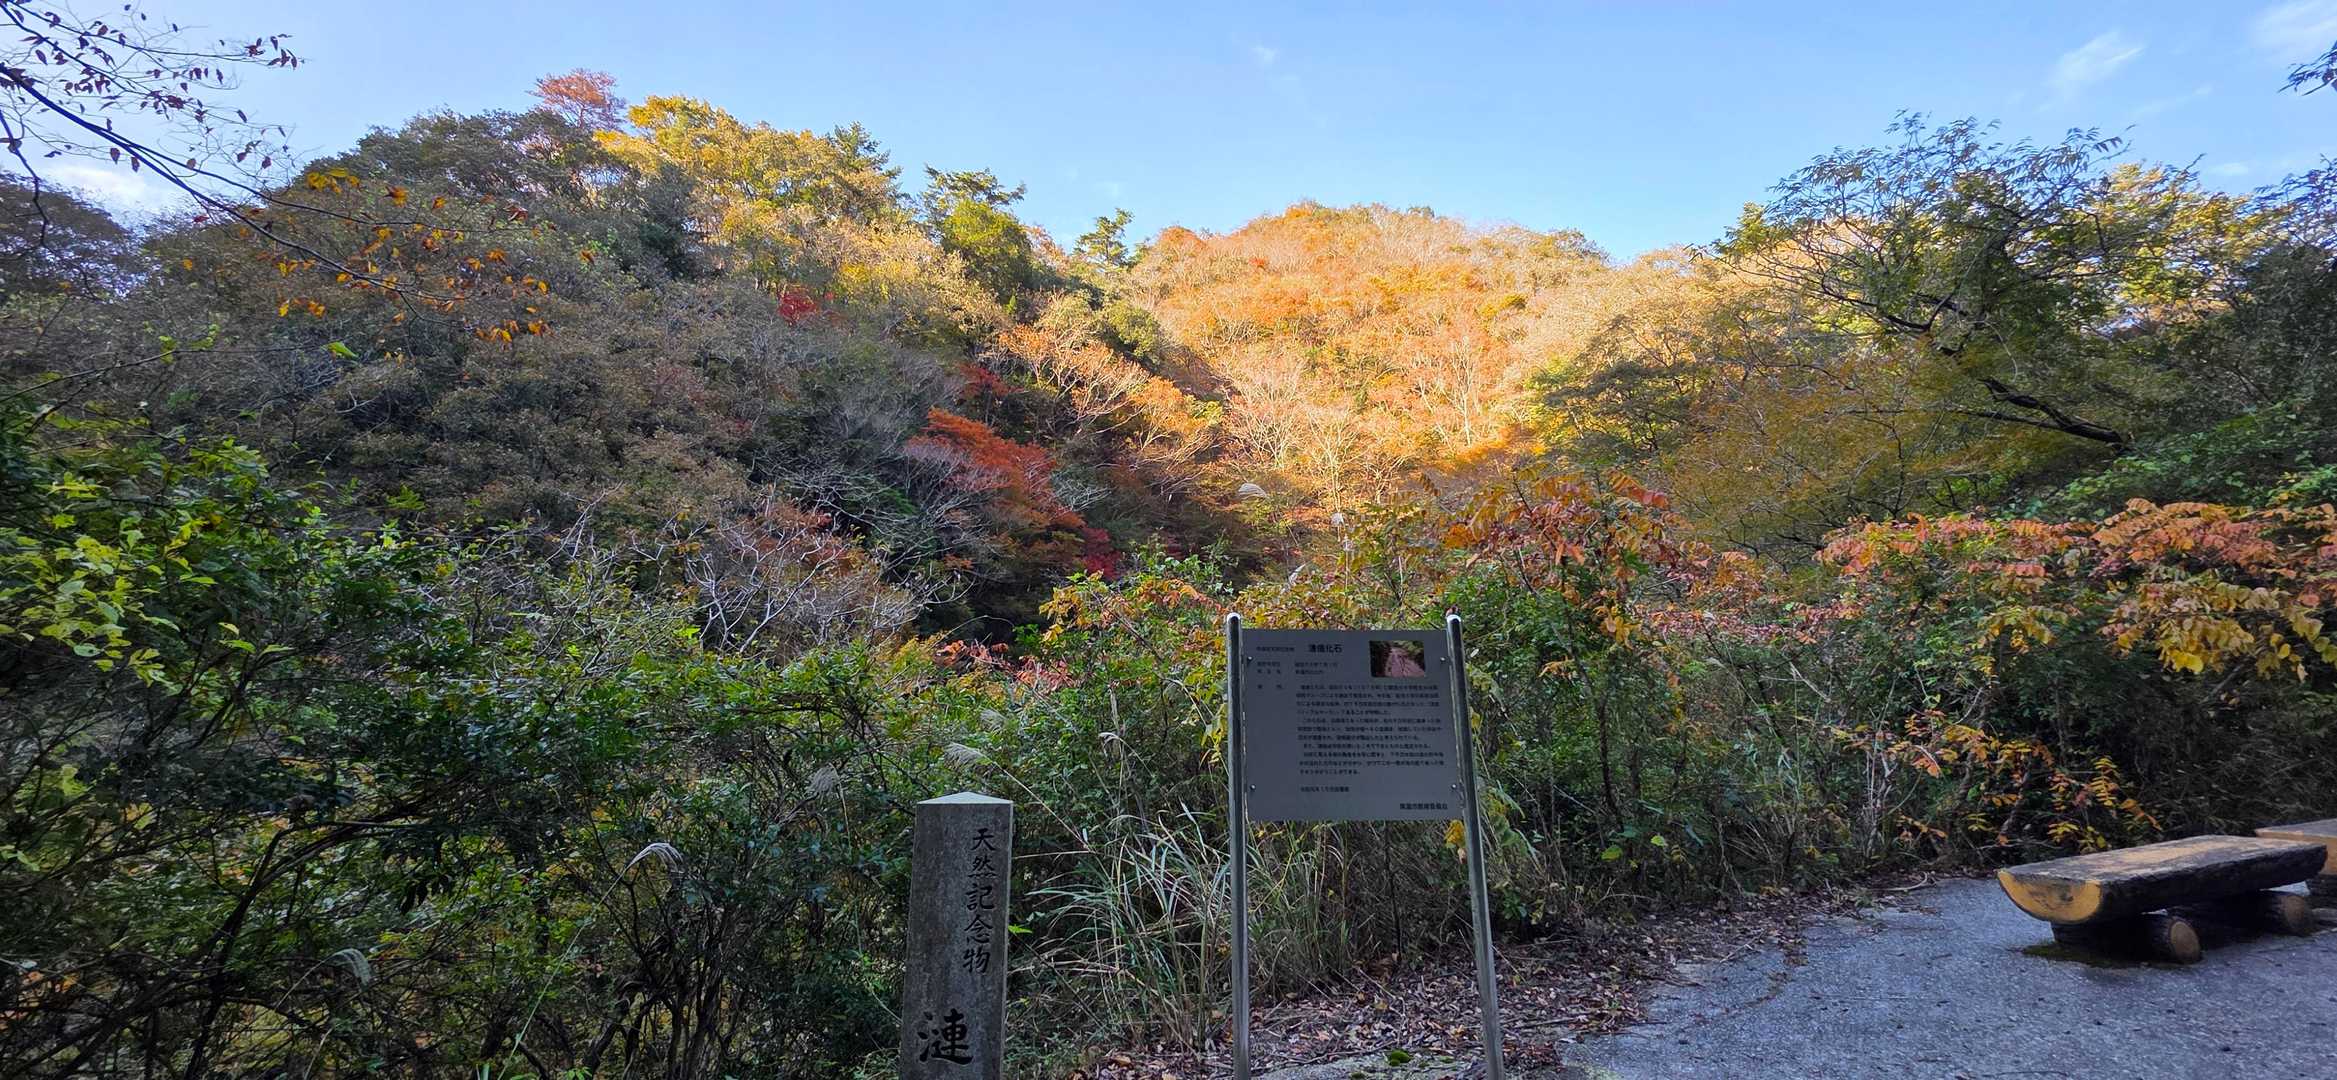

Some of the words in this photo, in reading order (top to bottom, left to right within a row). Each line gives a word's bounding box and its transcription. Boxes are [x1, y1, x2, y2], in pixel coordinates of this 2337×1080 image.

[962, 828, 999, 973] 天然記念物
[917, 1008, 974, 1066] 漣
